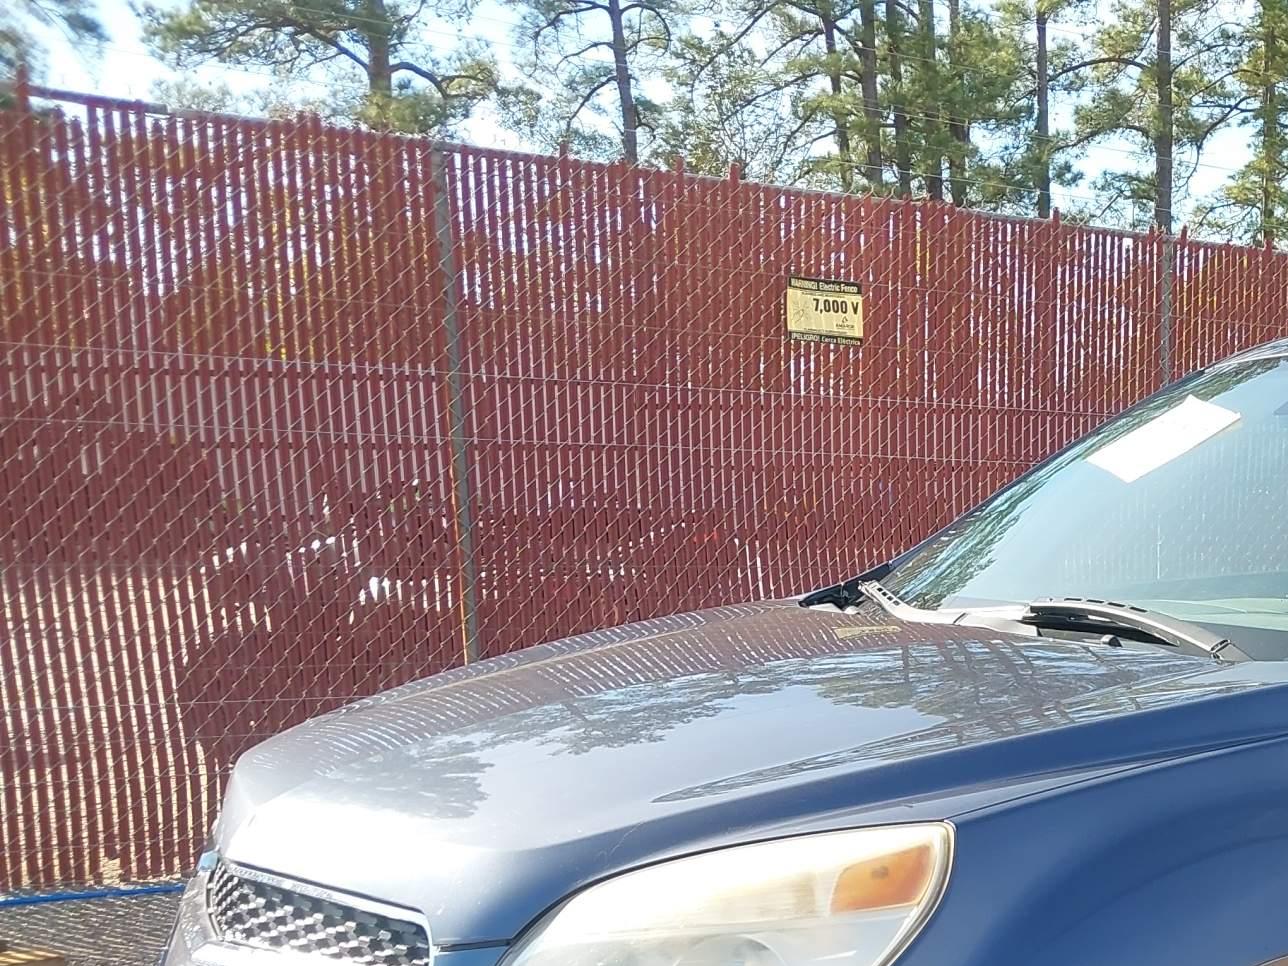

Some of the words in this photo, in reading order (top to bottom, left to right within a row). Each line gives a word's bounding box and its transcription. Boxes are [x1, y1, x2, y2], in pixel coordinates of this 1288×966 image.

[819, 281, 841, 292] Electric
[840, 283, 858, 293] Fence
[813, 298, 848, 315] 7,000
[851, 301, 859, 315] V
